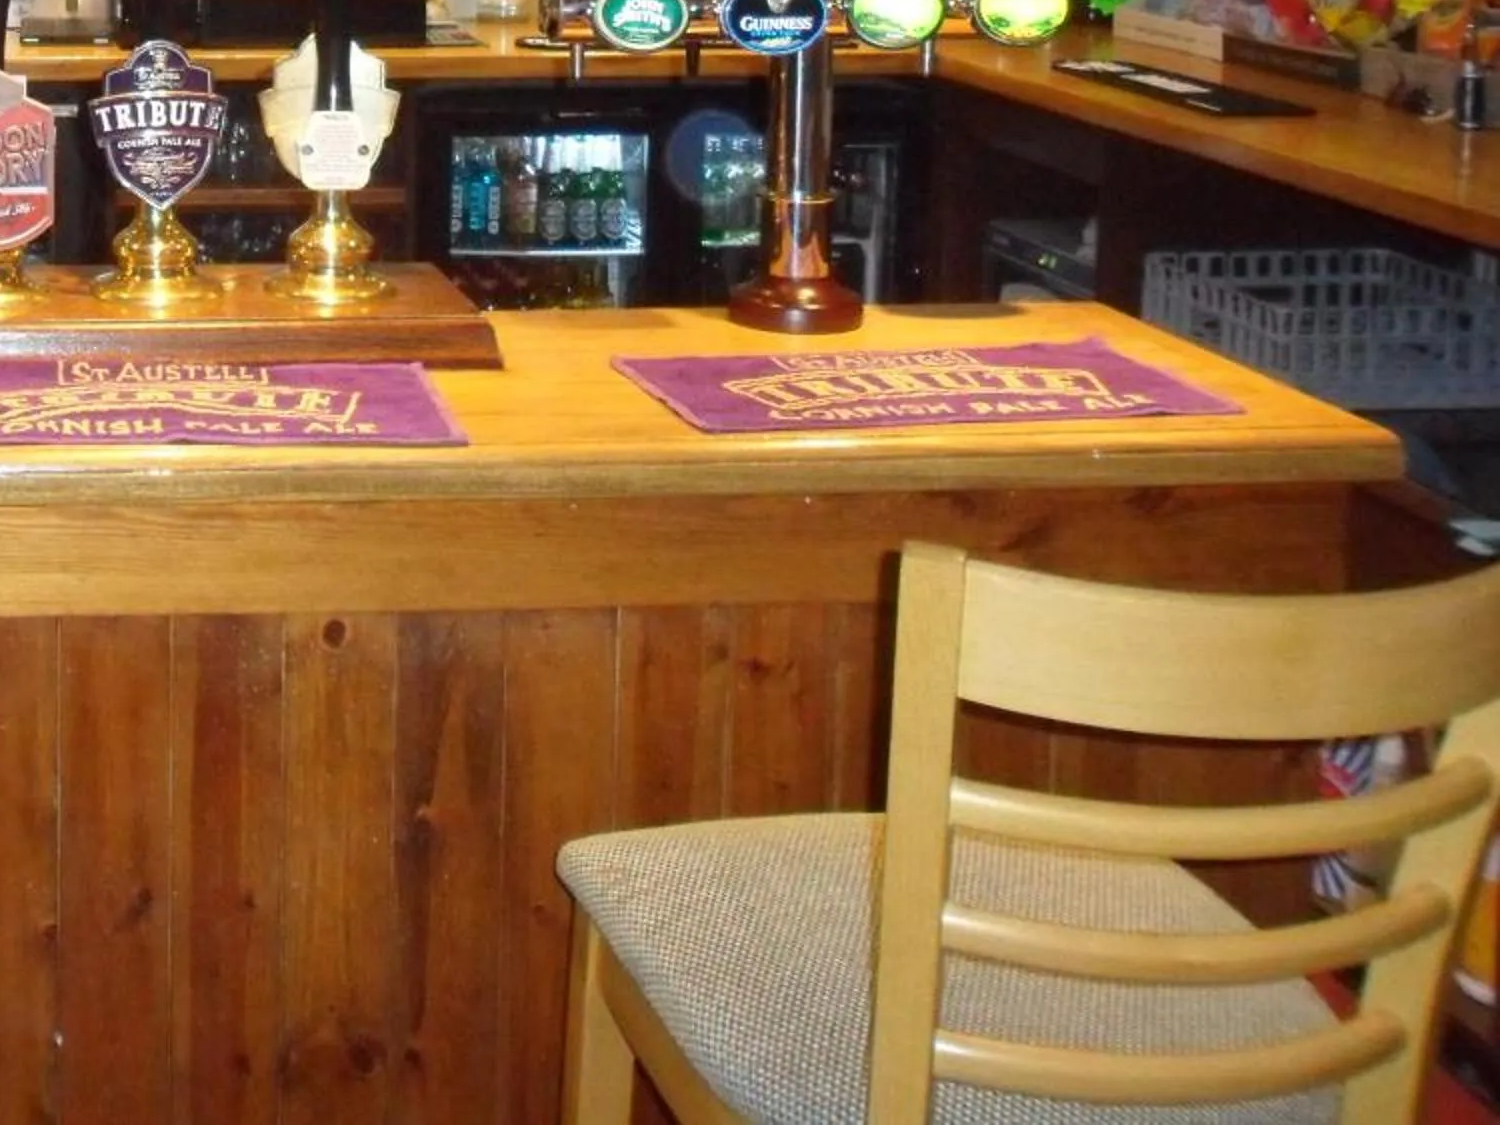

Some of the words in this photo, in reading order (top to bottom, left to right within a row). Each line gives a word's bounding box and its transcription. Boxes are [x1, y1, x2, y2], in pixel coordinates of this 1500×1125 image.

[739, 15, 814, 32] GUINNESS
[95, 100, 223, 132] TRIBUTE
[185, 138, 202, 148] ALE
[303, 421, 381, 435] ALE
